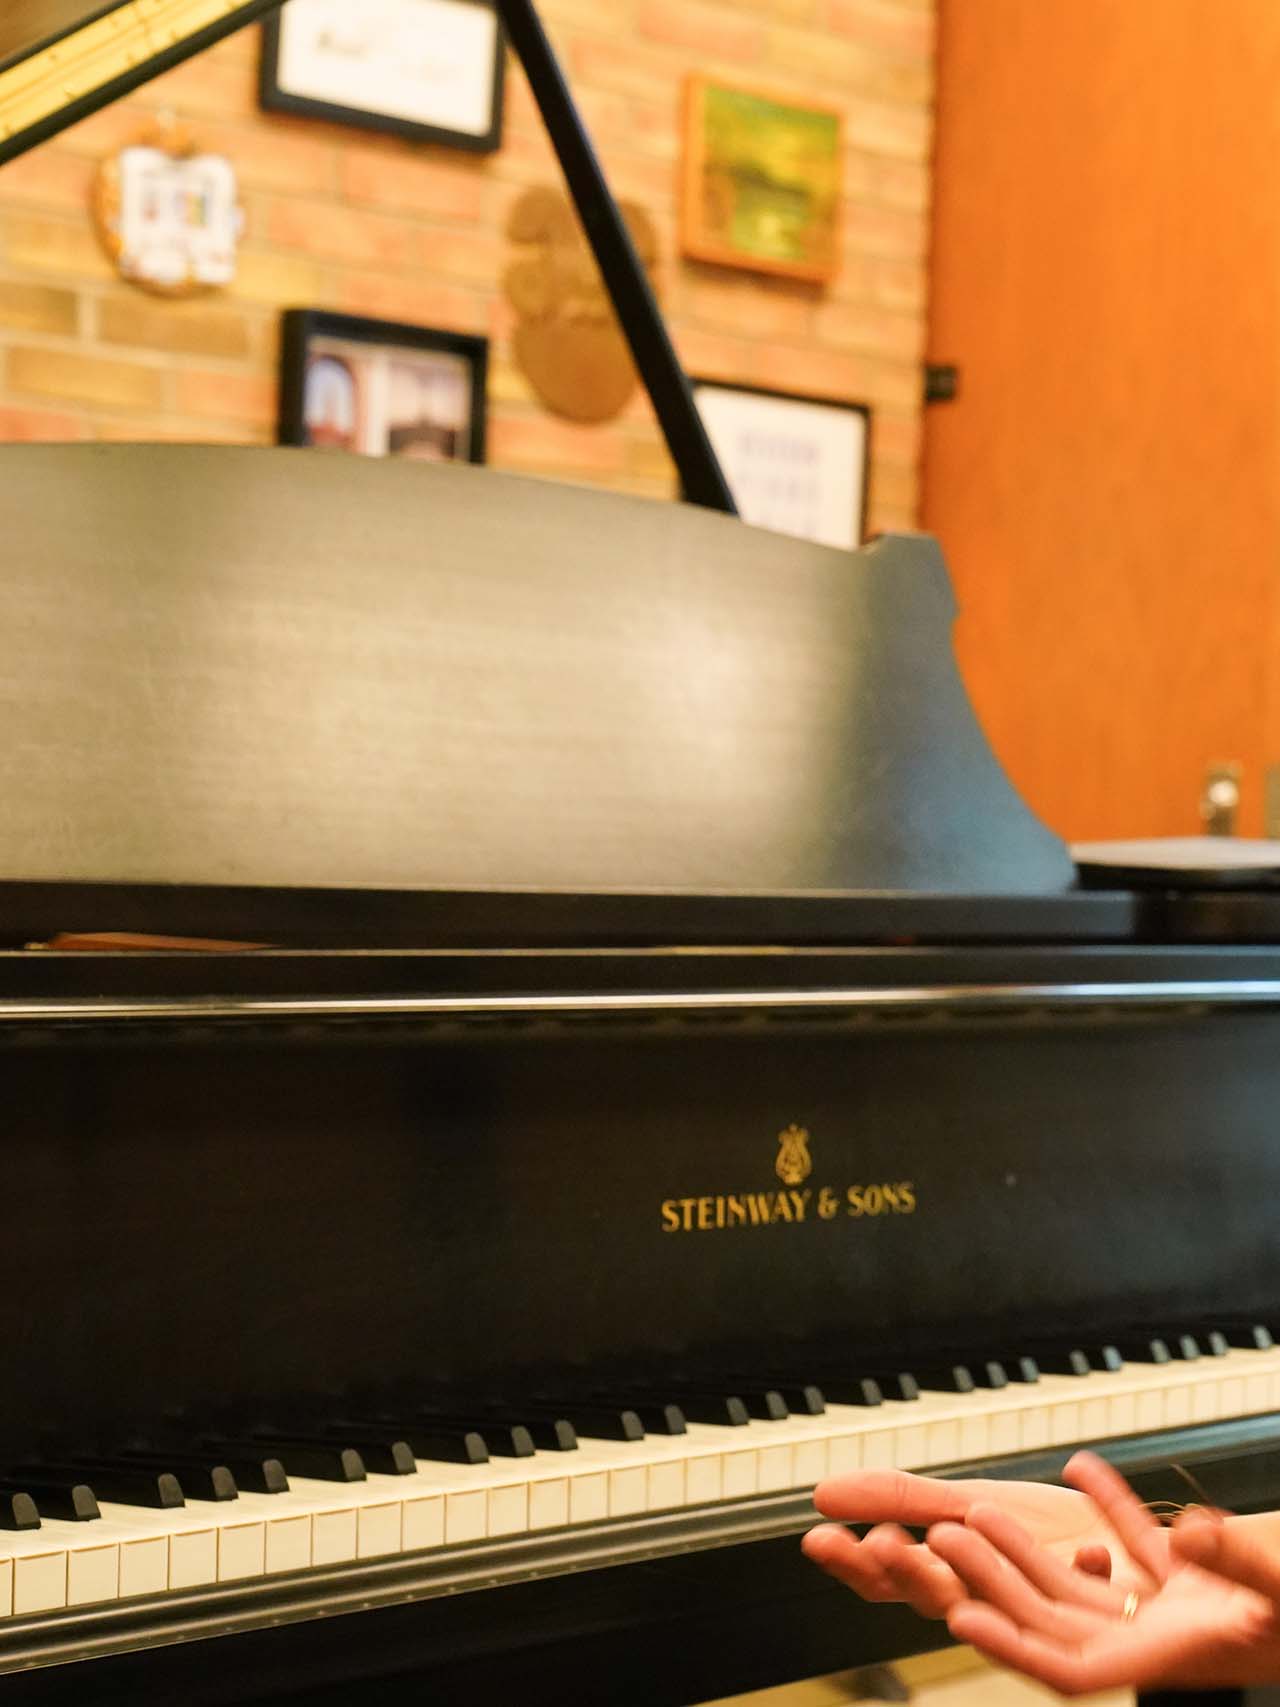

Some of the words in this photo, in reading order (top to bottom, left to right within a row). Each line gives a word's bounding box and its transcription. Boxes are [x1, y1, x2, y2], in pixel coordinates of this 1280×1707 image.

[661, 1189, 811, 1232] STEINWAY
[817, 1187, 840, 1220] &
[847, 1181, 916, 1217] SONS
